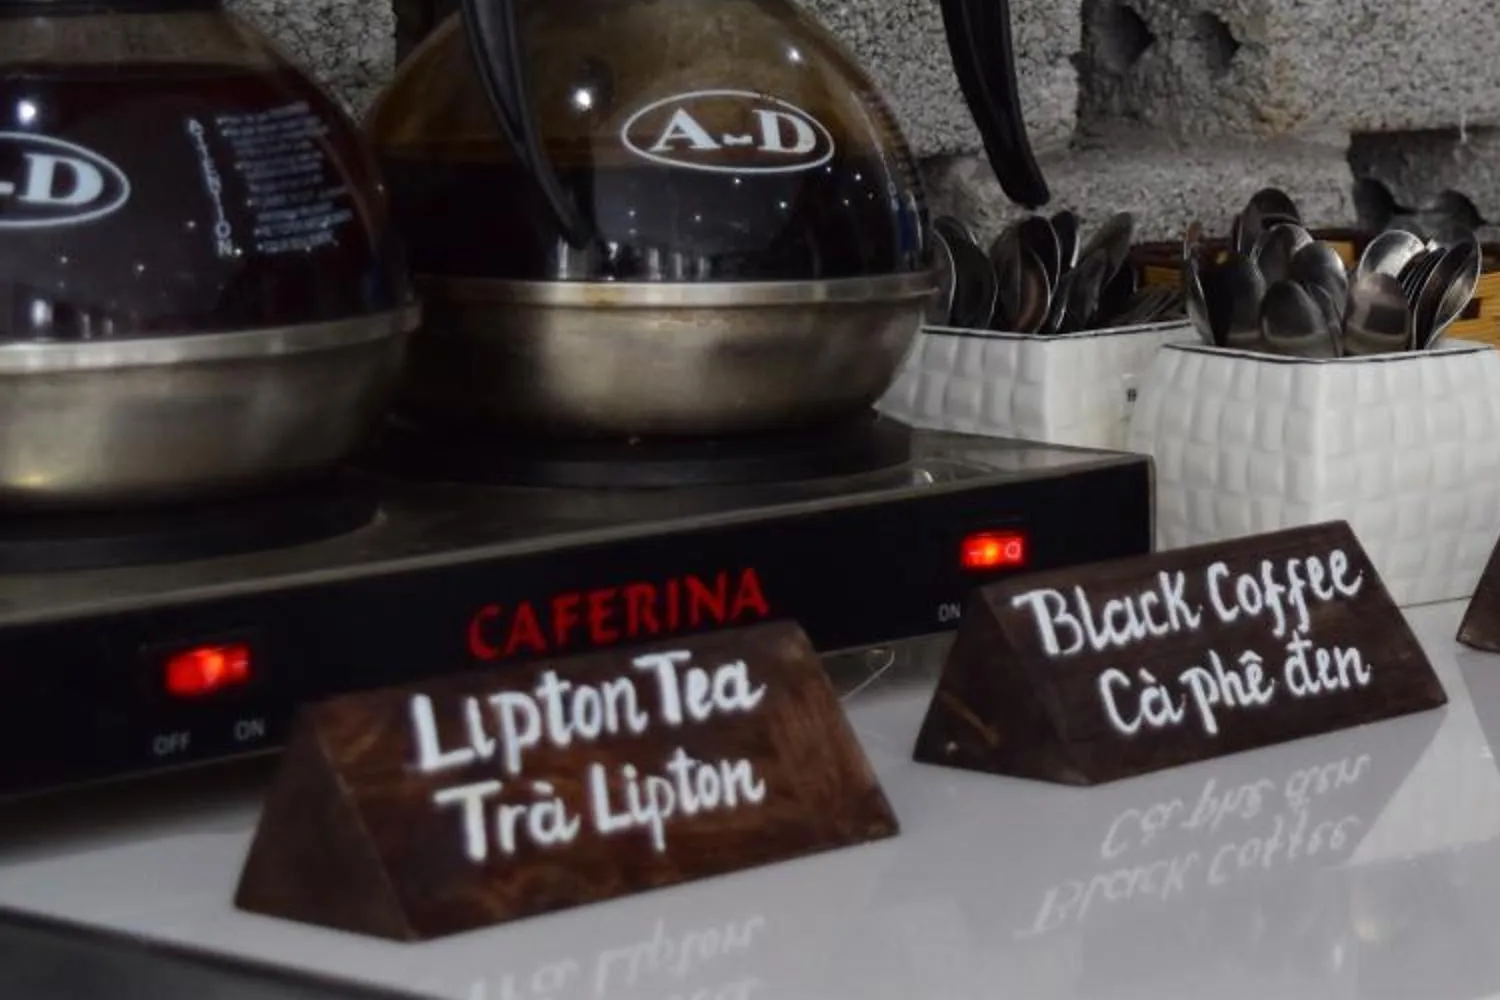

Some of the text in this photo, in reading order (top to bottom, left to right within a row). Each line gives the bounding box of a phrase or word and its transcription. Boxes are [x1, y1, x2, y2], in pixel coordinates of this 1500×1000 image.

[649, 106, 816, 154] A-D
[468, 567, 769, 660] CAFERINA
[938, 602, 961, 621] ON
[1208, 547, 1364, 638] Coffee
[411, 649, 767, 774] Lipton Tea
[1098, 629, 1371, 737] Cà phê đen
[234, 719, 266, 741] ON
[433, 746, 766, 861] Trà Lipton
